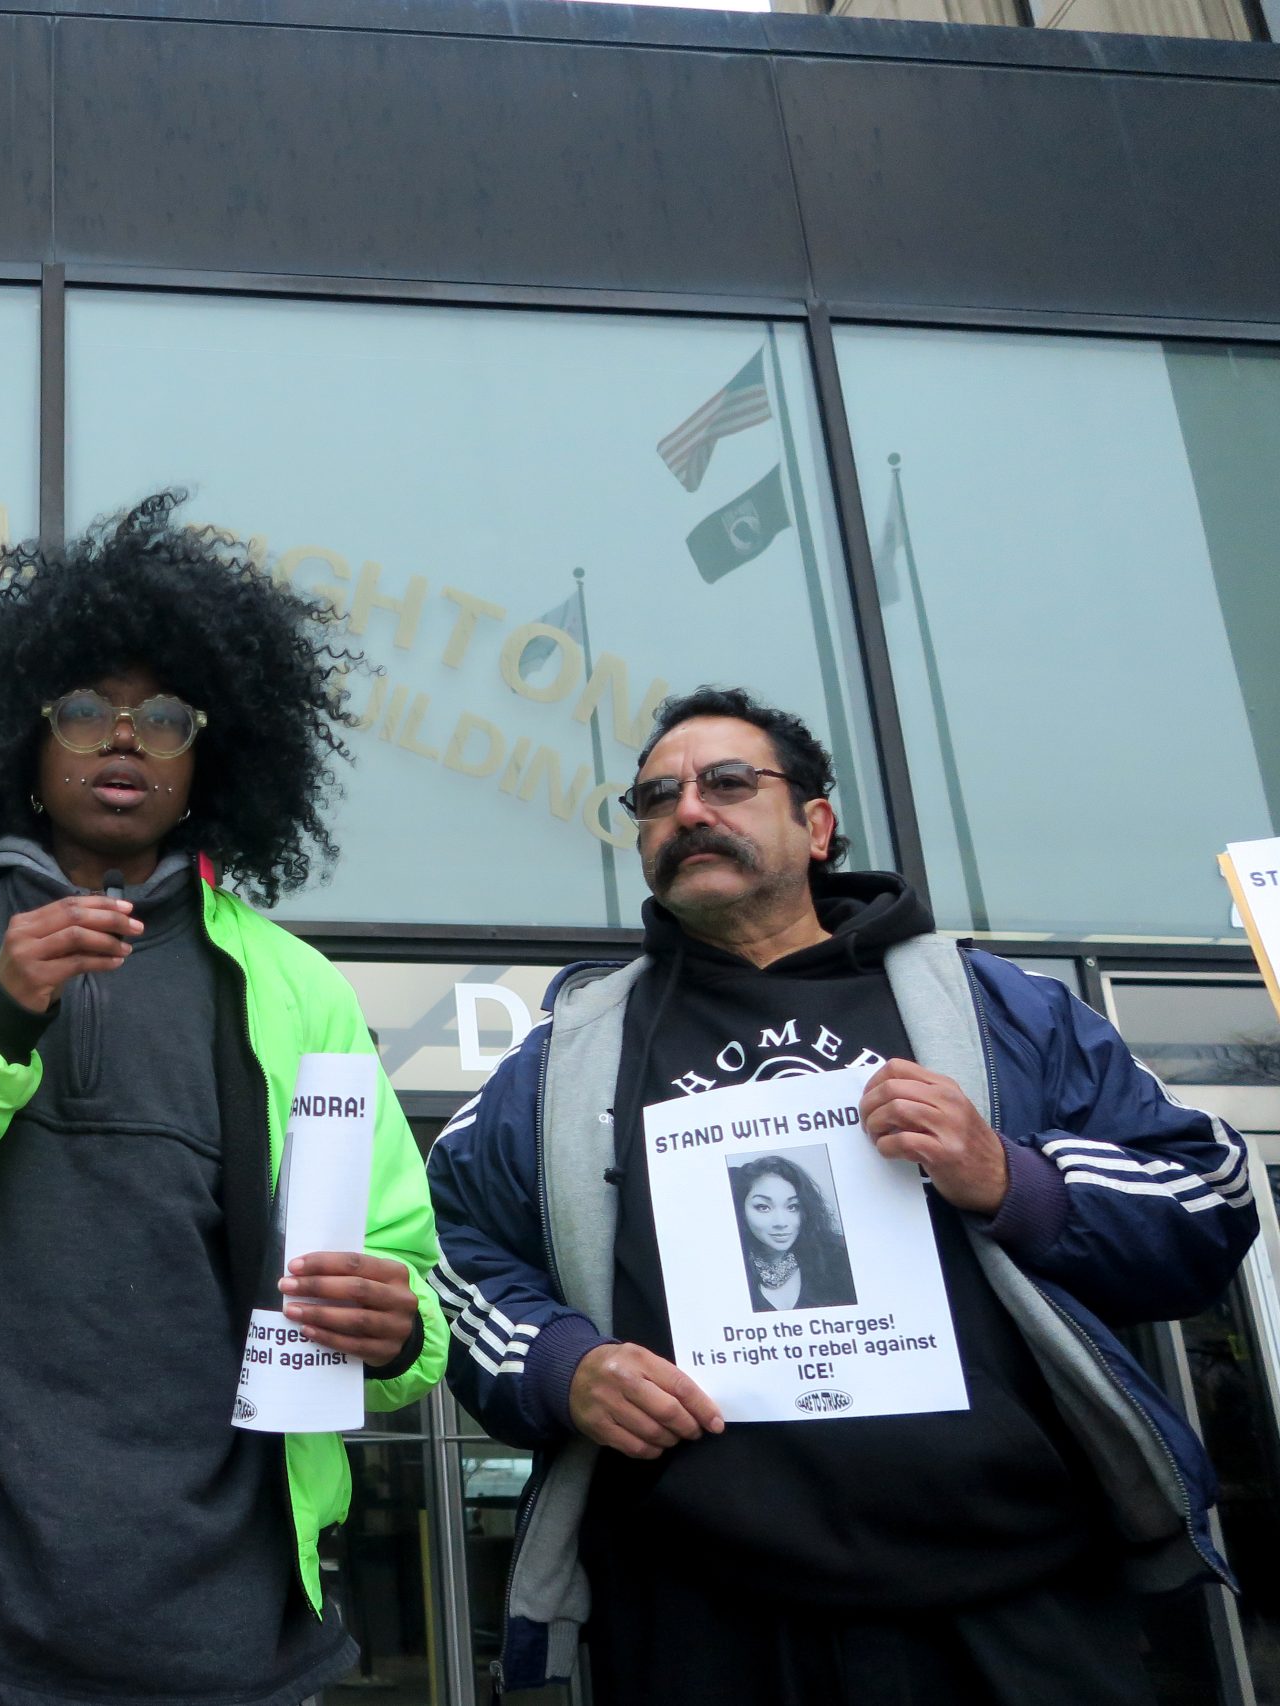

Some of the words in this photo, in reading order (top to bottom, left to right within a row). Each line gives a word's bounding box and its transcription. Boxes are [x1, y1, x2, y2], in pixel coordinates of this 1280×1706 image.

[326, 660, 638, 849] UILDING
[454, 983, 533, 1071] D
[656, 1125, 723, 1153] STAND
[732, 1116, 789, 1139] WITH
[797, 1104, 860, 1131] SAND
[724, 1327, 767, 1342] Drop
[773, 1322, 802, 1337] the
[810, 1314, 894, 1335] Charges!
[280, 1349, 348, 1370] against
[692, 1351, 705, 1366] It
[711, 1350, 726, 1364] is
[733, 1346, 778, 1365] right
[784, 1345, 802, 1358] to
[809, 1339, 857, 1357] rebel
[864, 1335, 937, 1355] against
[798, 1363, 834, 1380] ICE!
